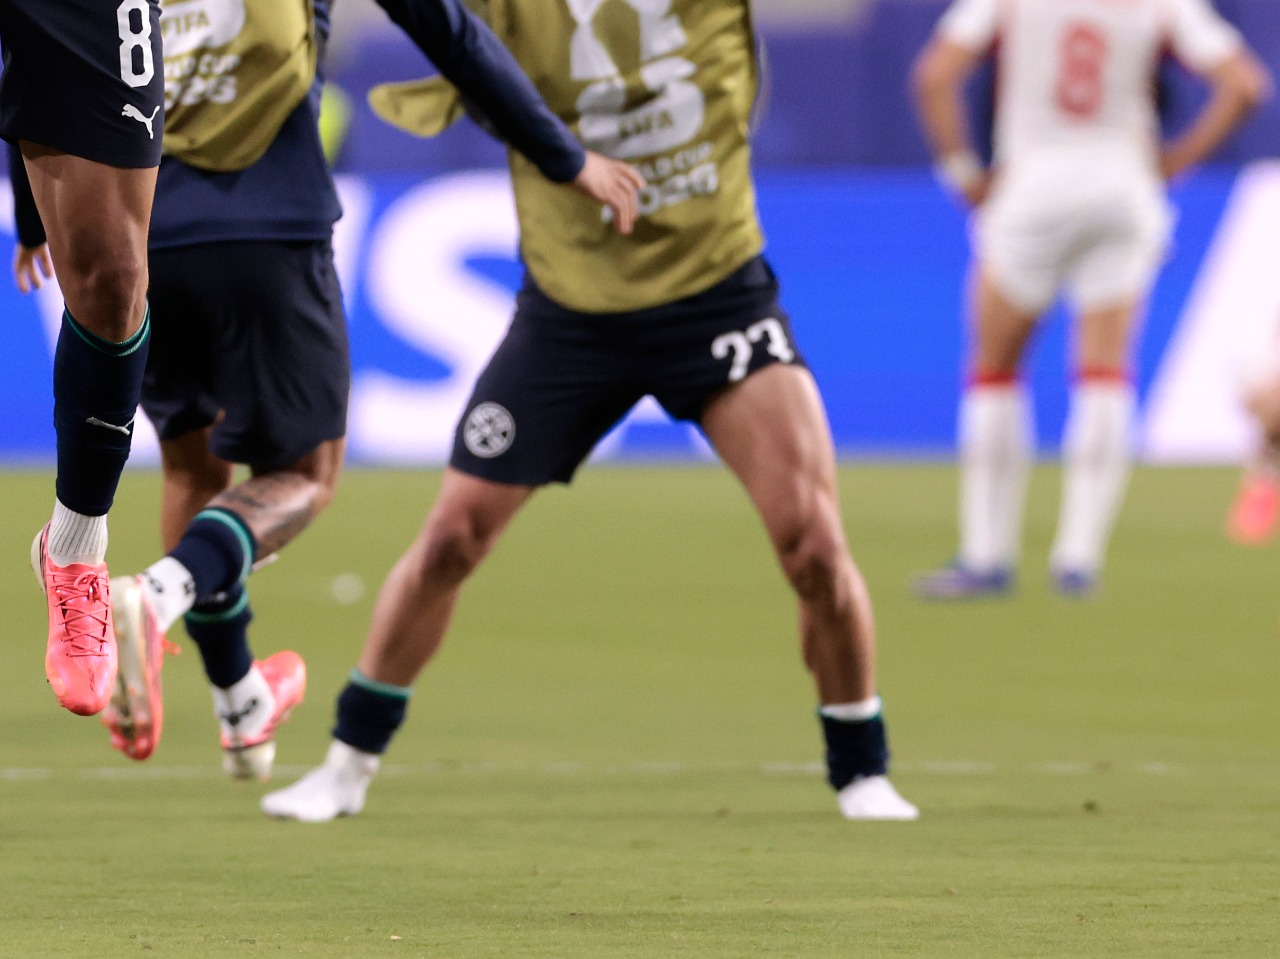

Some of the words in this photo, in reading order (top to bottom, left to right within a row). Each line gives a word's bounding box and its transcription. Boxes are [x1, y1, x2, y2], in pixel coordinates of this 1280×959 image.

[164, 73, 238, 112] 026
[1056, 22, 1108, 121] 8
[601, 162, 719, 224] 026
